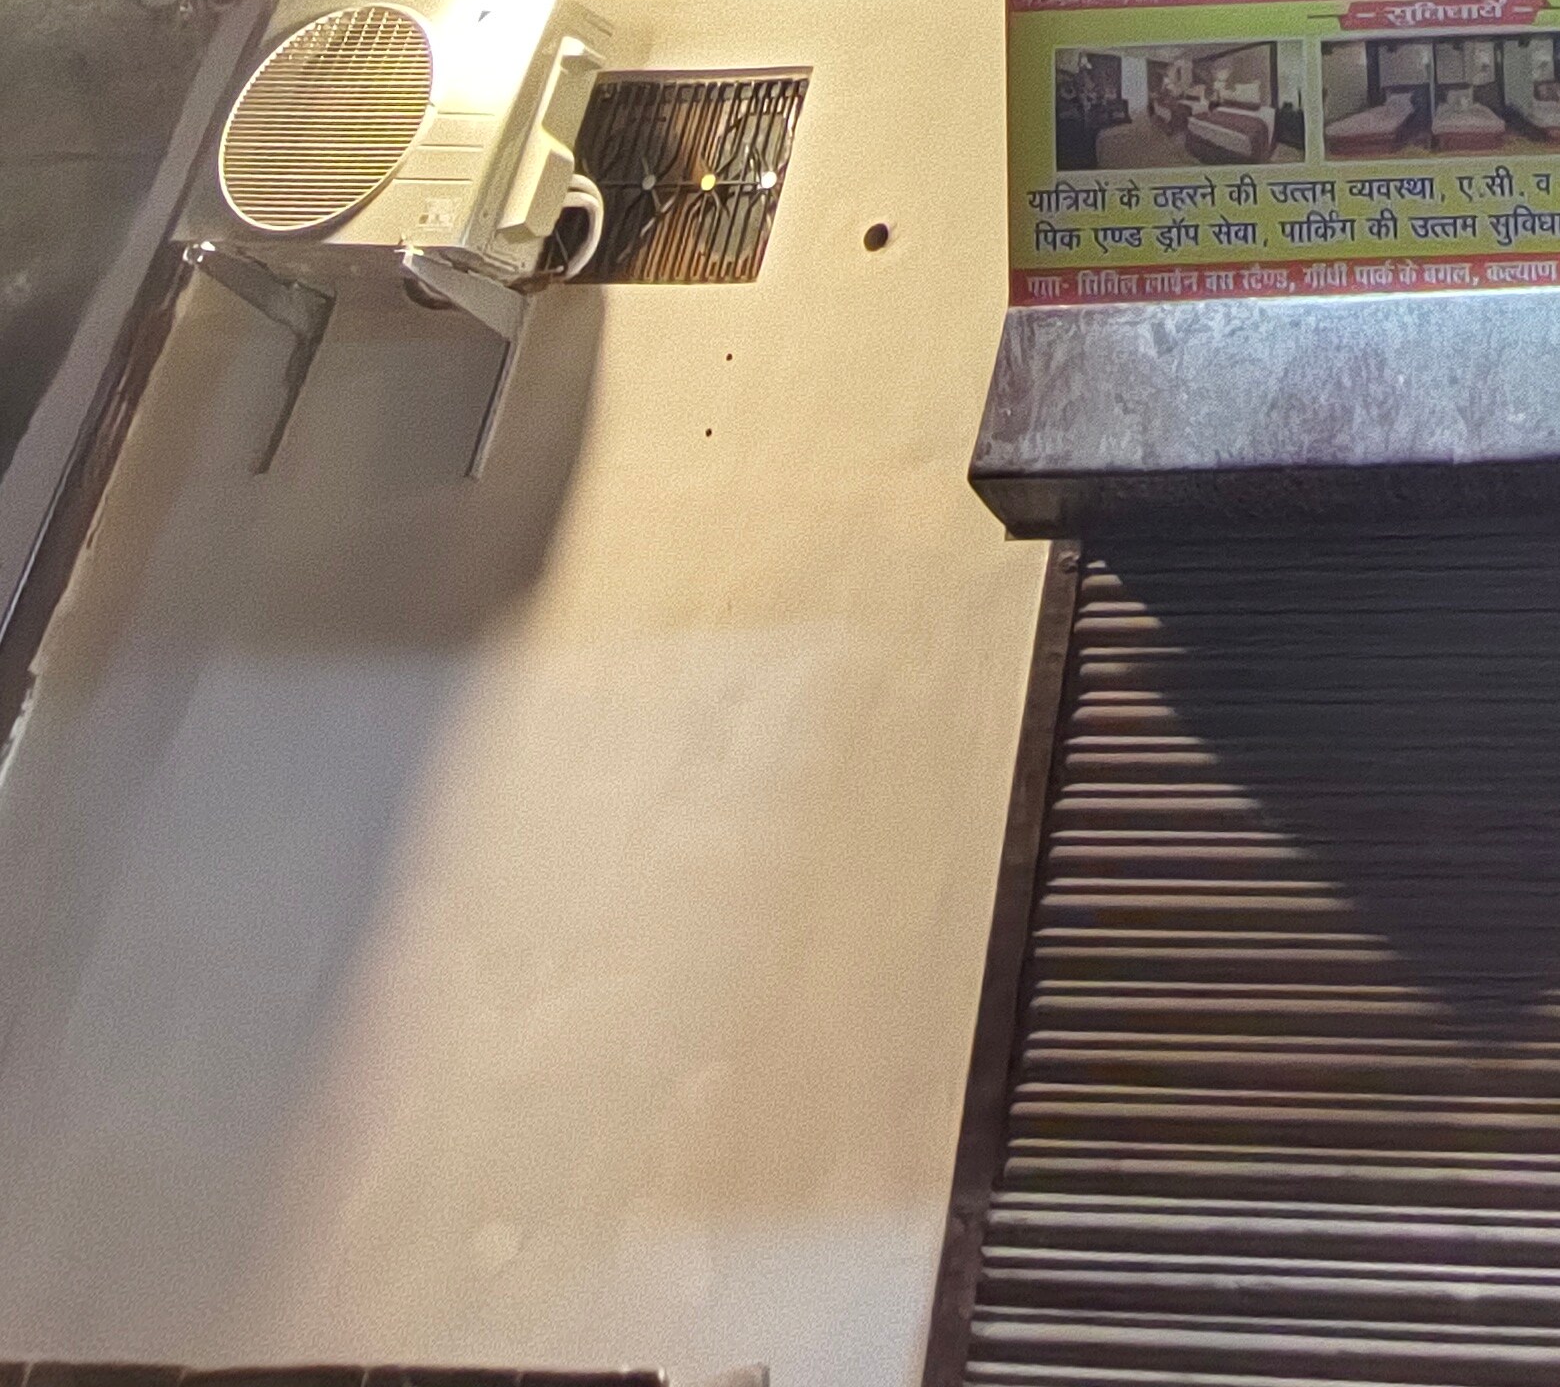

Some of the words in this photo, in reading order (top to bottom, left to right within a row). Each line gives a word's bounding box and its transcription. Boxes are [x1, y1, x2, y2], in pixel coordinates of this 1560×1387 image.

[1027, 179, 1109, 212] यात्रियों
[1116, 179, 1140, 210] के
[1150, 176, 1216, 211] ठहरने
[1225, 174, 1257, 206] की
[1267, 179, 1336, 204] उत्तम
[1533, 173, 1550, 195] व
[1034, 220, 1081, 252] पिक
[1092, 227, 1143, 254] एण्ड
[1152, 217, 1199, 252] ड्रॉप
[1366, 208, 1398, 240] की
[1408, 214, 1477, 239] उत्तम
